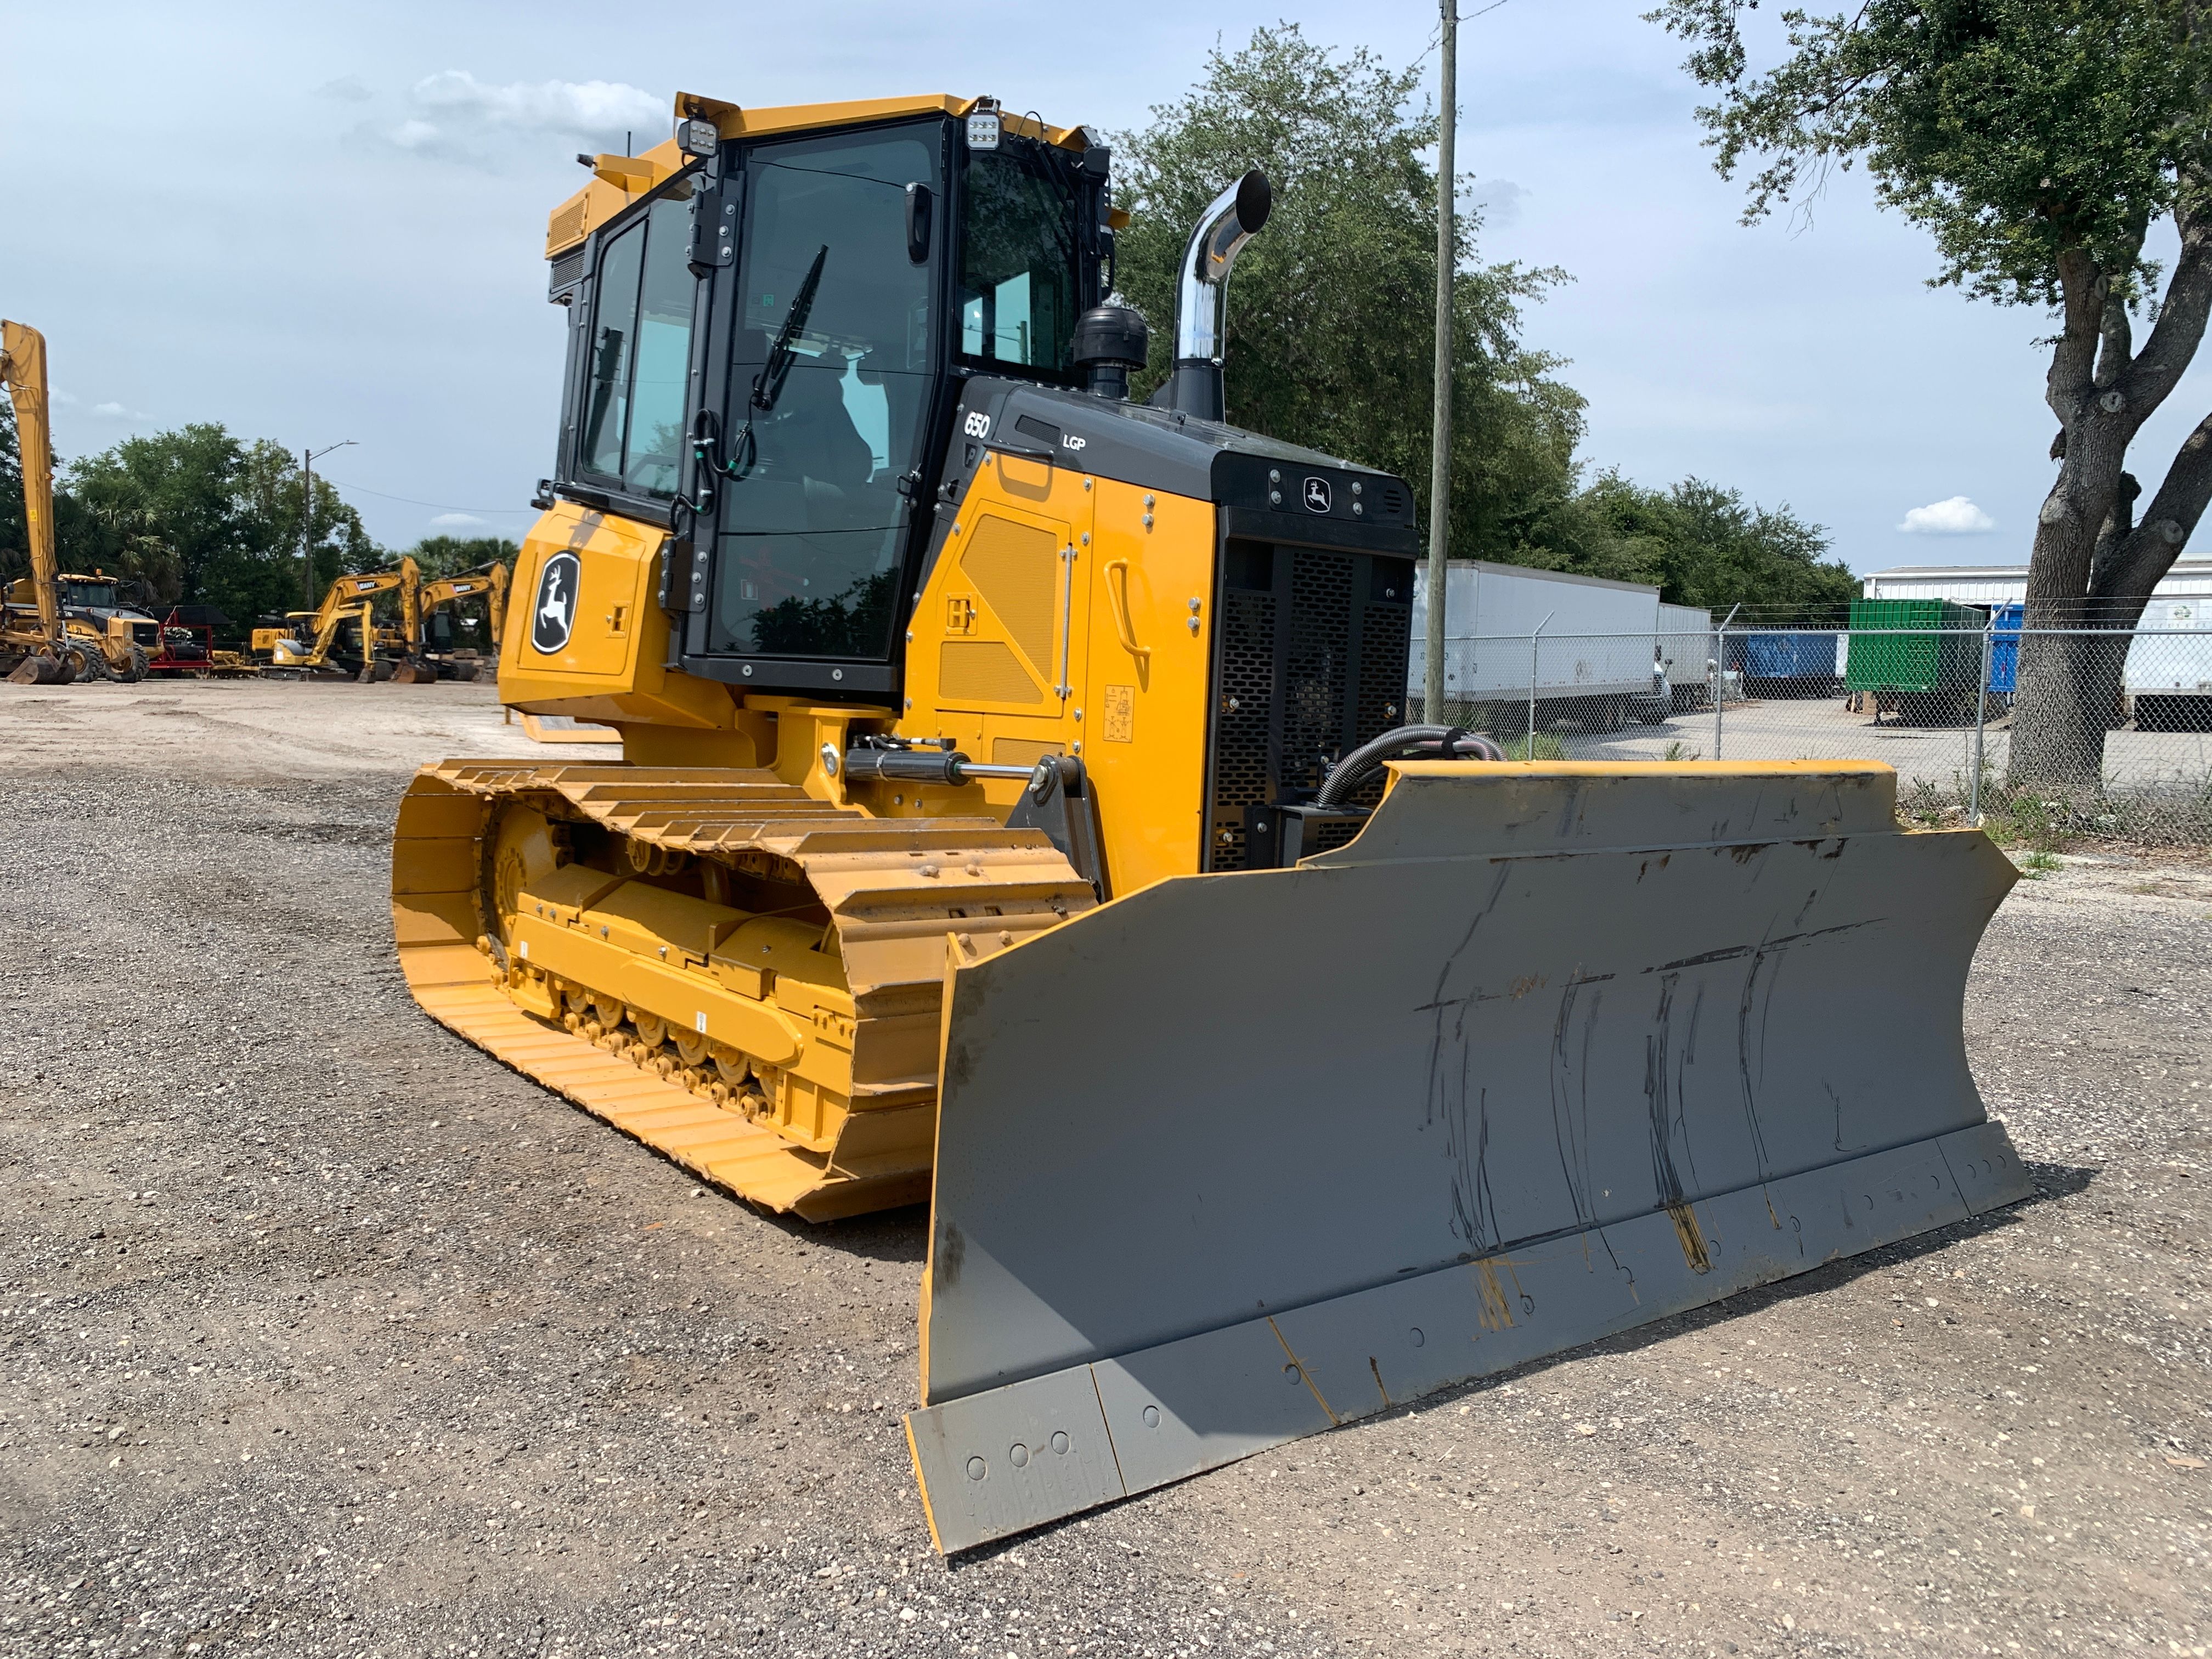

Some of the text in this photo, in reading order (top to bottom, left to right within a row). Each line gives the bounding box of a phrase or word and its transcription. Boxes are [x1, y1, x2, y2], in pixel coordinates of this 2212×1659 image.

[964, 411, 991, 438] 650
[1063, 434, 1086, 451] LGP
[966, 448, 976, 465] P
